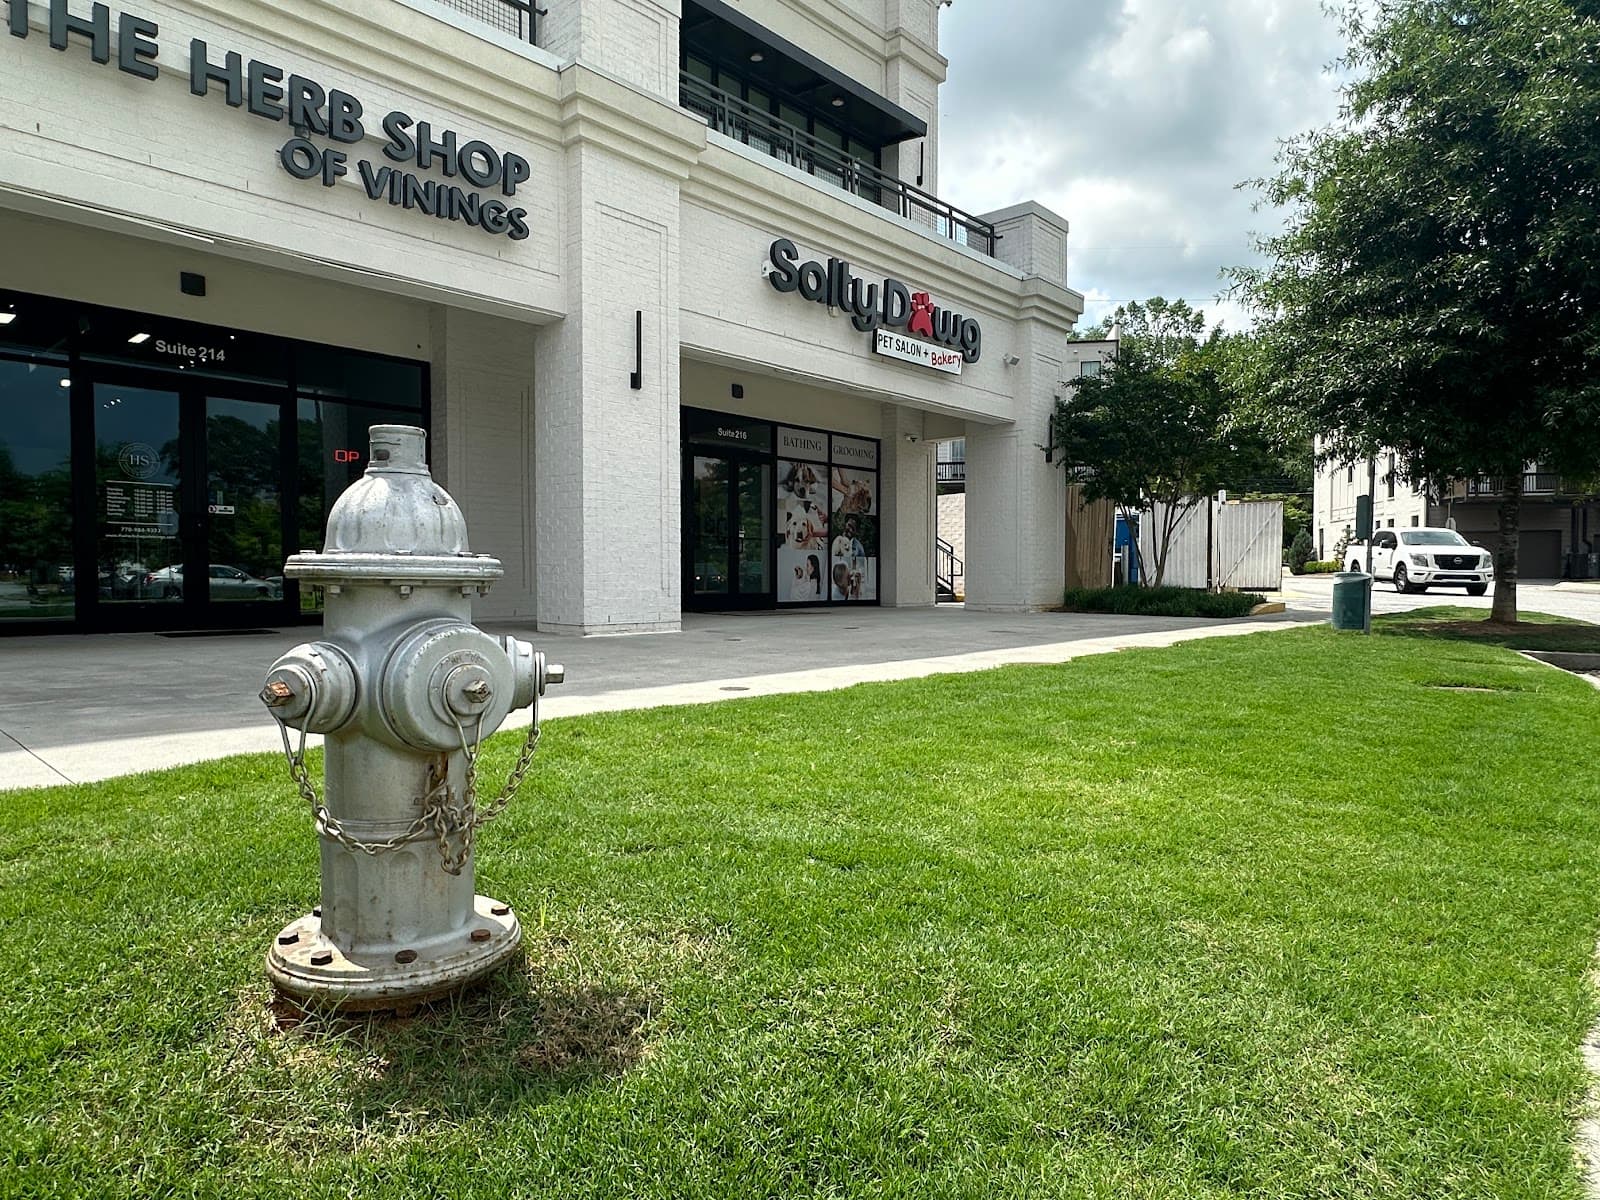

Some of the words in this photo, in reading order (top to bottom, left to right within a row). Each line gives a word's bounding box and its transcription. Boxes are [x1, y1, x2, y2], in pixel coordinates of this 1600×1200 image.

[190, 38, 364, 144] HERB
[382, 111, 531, 197] SHOP
[281, 138, 347, 187] OF
[357, 160, 530, 241] VININGS
[768, 238, 878, 332] Salty
[155, 339, 197, 357] Suite
[198, 346, 225, 361] 214
[877, 333, 894, 350] PET
[895, 338, 922, 358] SALON
[931, 351, 962, 368] Bakery
[717, 426, 735, 438] Suite
[783, 434, 822, 452] BATHING
[833, 444, 875, 460] GROOMING
